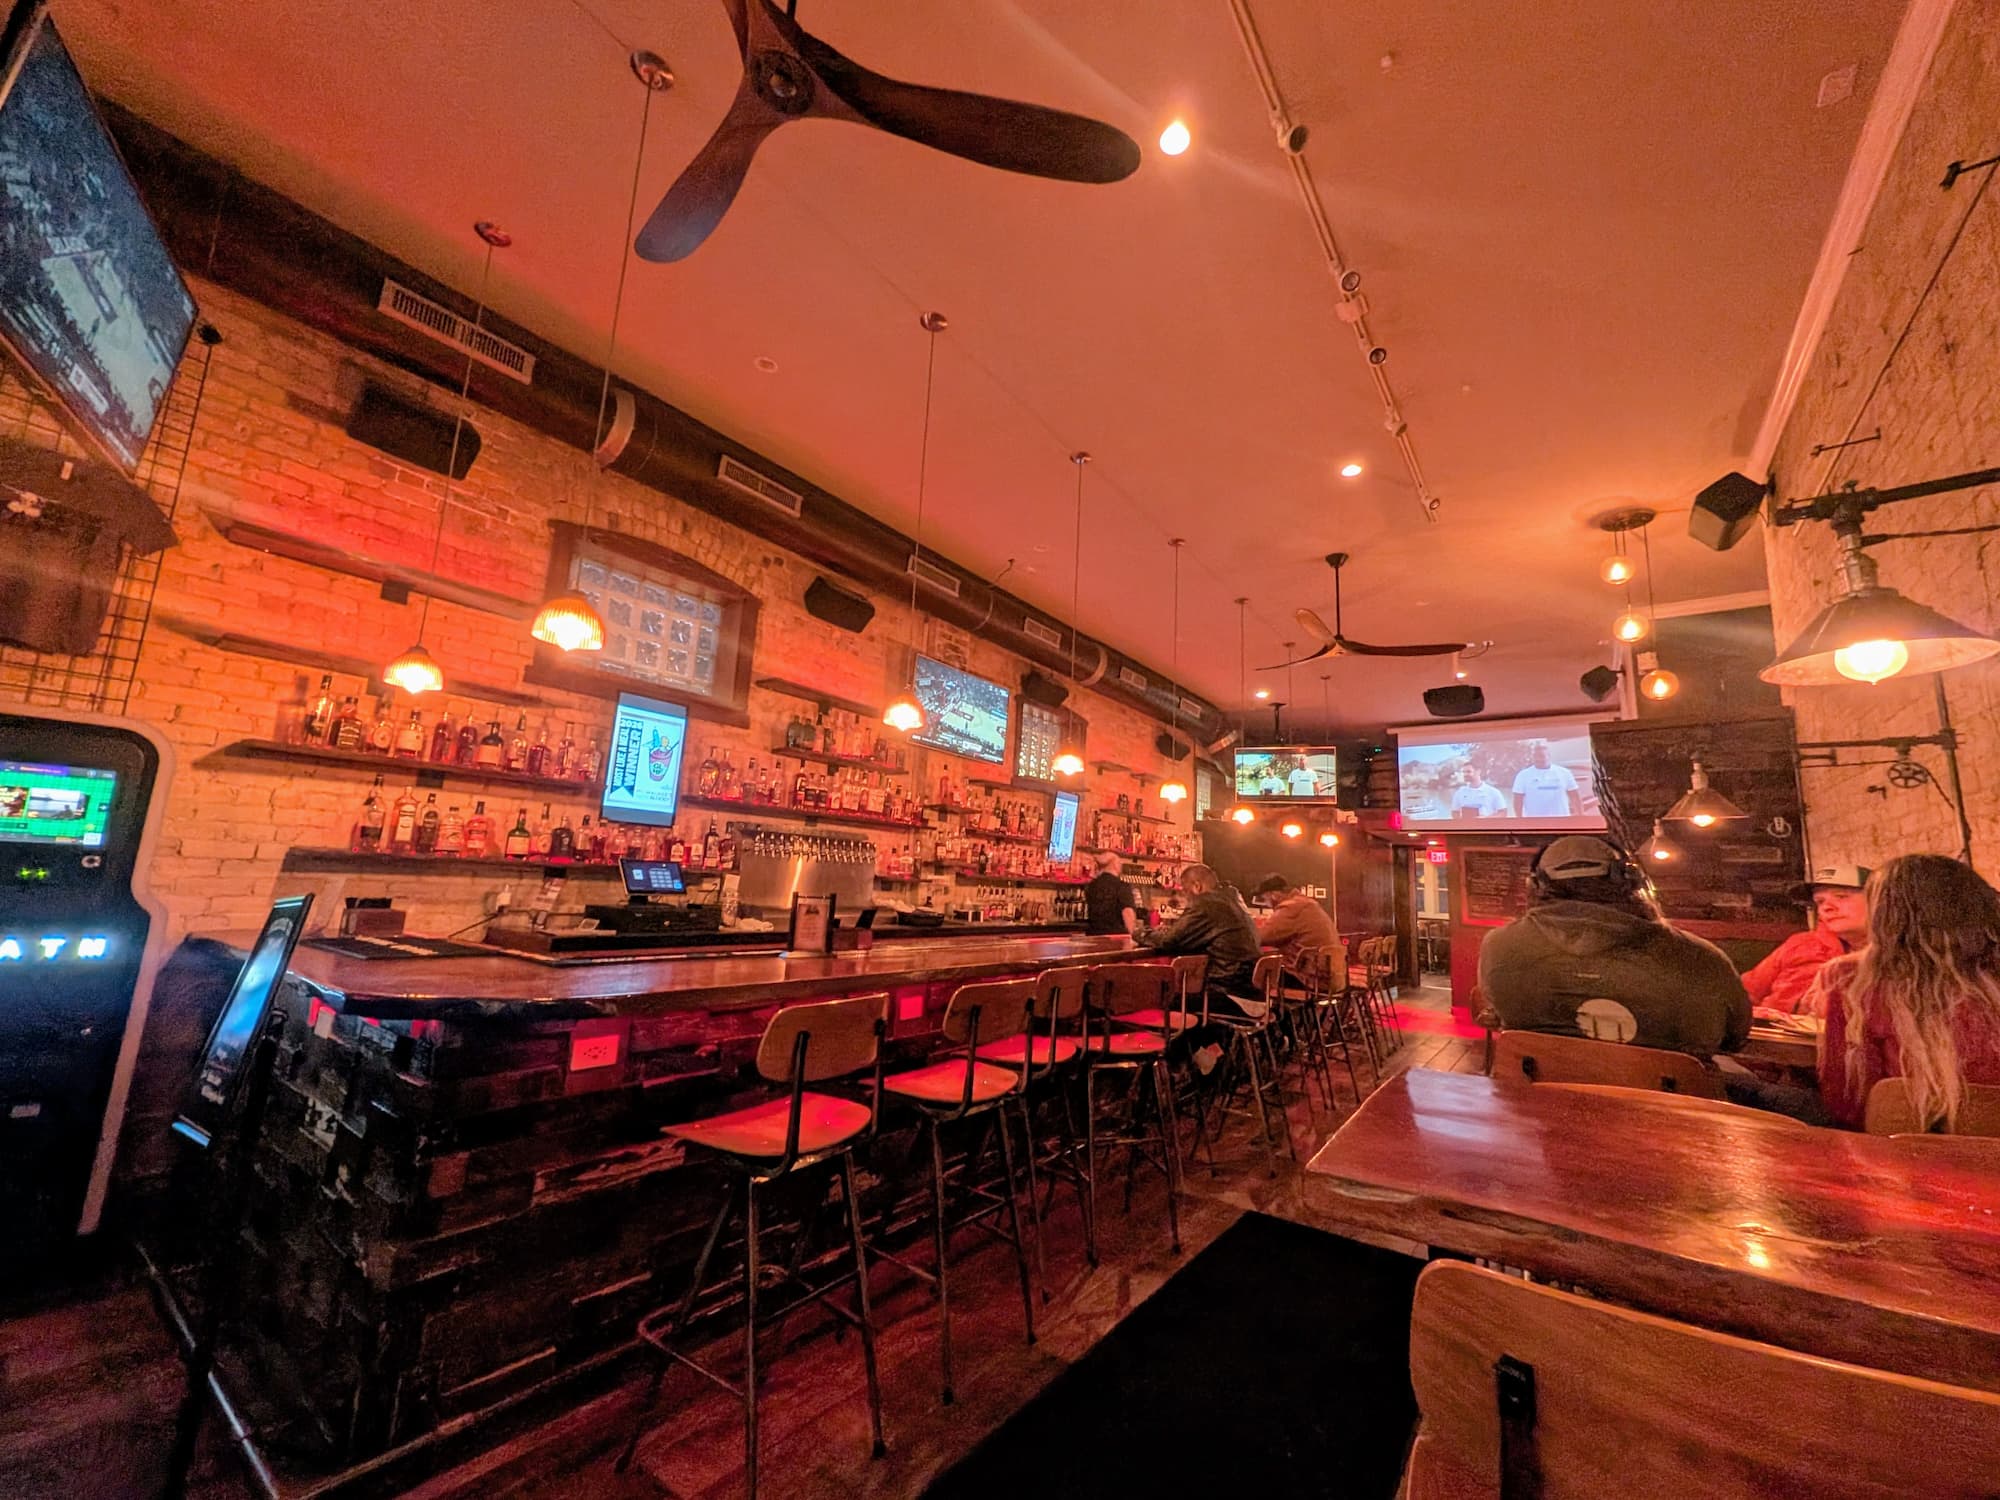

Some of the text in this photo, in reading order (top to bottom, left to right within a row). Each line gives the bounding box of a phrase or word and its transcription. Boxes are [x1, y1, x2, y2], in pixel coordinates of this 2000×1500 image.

[615, 752, 627, 768] LIKE
[624, 730, 642, 787] WINNER
[0, 937, 107, 960] ATM
